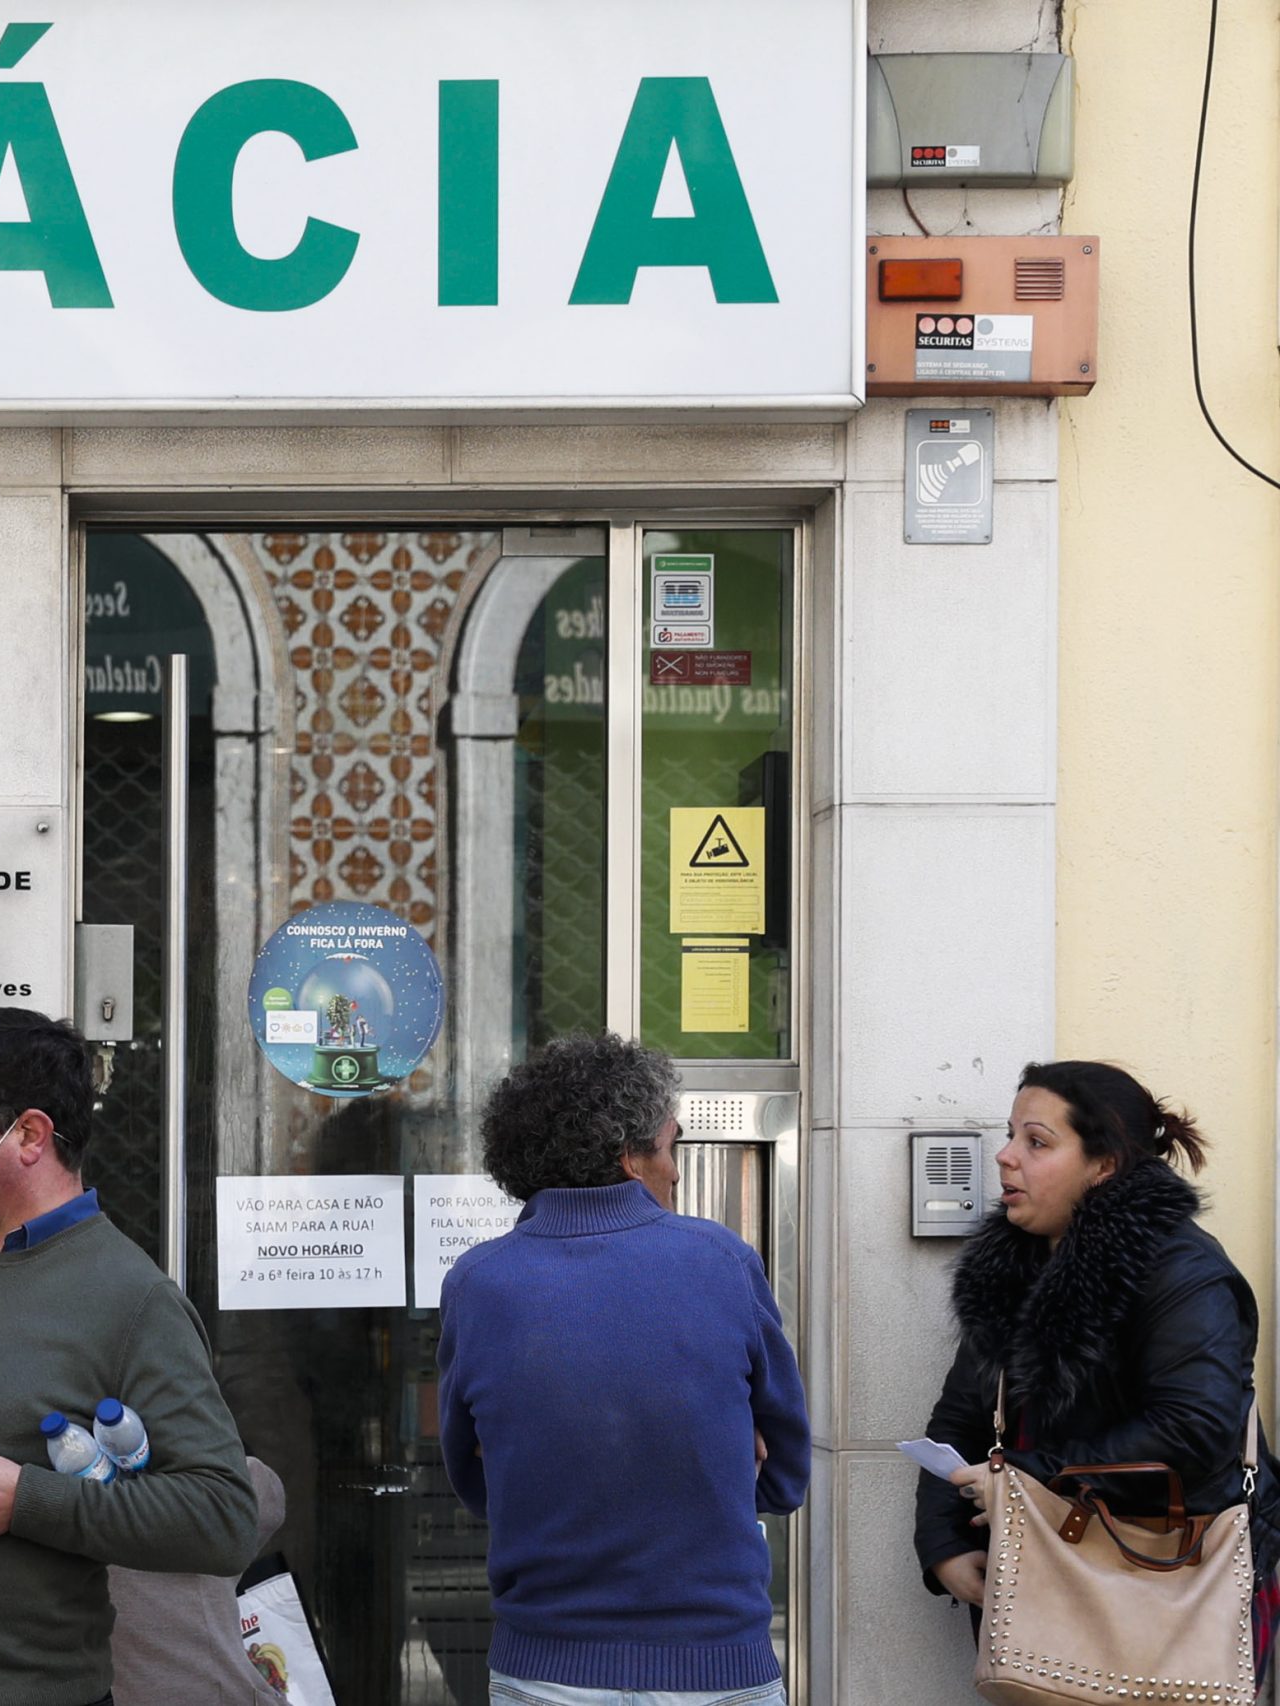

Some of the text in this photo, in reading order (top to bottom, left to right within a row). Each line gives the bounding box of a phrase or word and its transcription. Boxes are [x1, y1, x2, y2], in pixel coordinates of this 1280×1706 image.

[918, 337, 1029, 347] SECURITAS SYSTEMS
[286, 925, 407, 936] CONNOSCO O INVERNO
[311, 936, 383, 948] FICA LÁ FORA
[237, 1196, 383, 1211] VÃO PARA CASA E NÃO
[430, 1197, 526, 1208] POR FAVOR, REA
[247, 1219, 373, 1233] SAIAM PARA A RUA!
[431, 1217, 454, 1228] FILA
[457, 1217, 492, 1228] ÚNICA
[495, 1217, 509, 1228] DE
[258, 1243, 363, 1258] NOVO HORÁRIO
[439, 1255, 455, 1266] ME
[241, 1267, 382, 1281] 2ª a 6ª feira 10 às 17 h
[241, 1613, 259, 1631] hé
